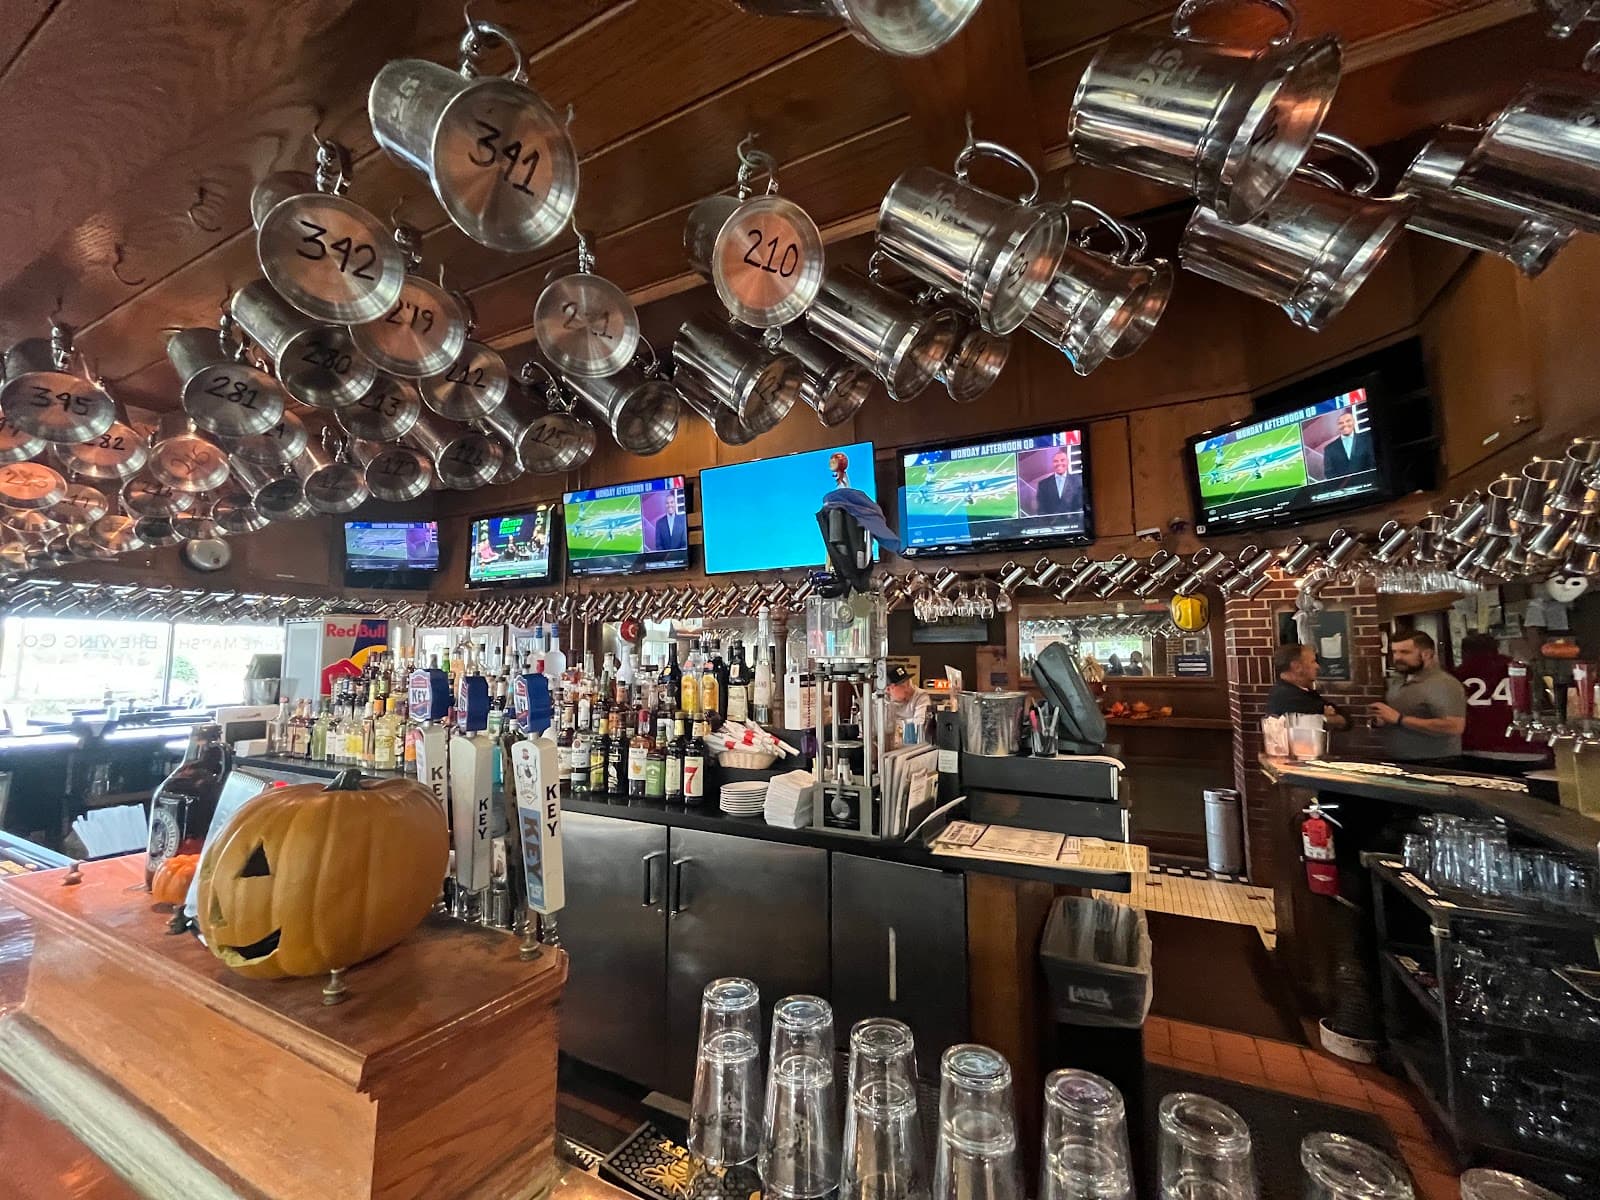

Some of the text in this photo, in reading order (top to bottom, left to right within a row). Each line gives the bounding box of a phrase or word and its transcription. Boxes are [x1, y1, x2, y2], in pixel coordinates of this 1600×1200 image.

[743, 229, 799, 278] 210
[562, 302, 613, 340] 21
[302, 337, 353, 375] 280
[203, 376, 259, 409] 281
[1235, 424, 1264, 440] MONDAY
[1264, 408, 1305, 431] AFTERNOON
[950, 438, 1034, 460] MONDAY AFTERNOON QB
[326, 623, 386, 638] Red Bull
[1463, 677, 1513, 706] 24
[431, 766, 443, 803] KE
[684, 766, 699, 795] 7
[479, 798, 488, 840] KEY
[546, 783, 559, 837] KEY
[524, 816, 544, 886] KEY
